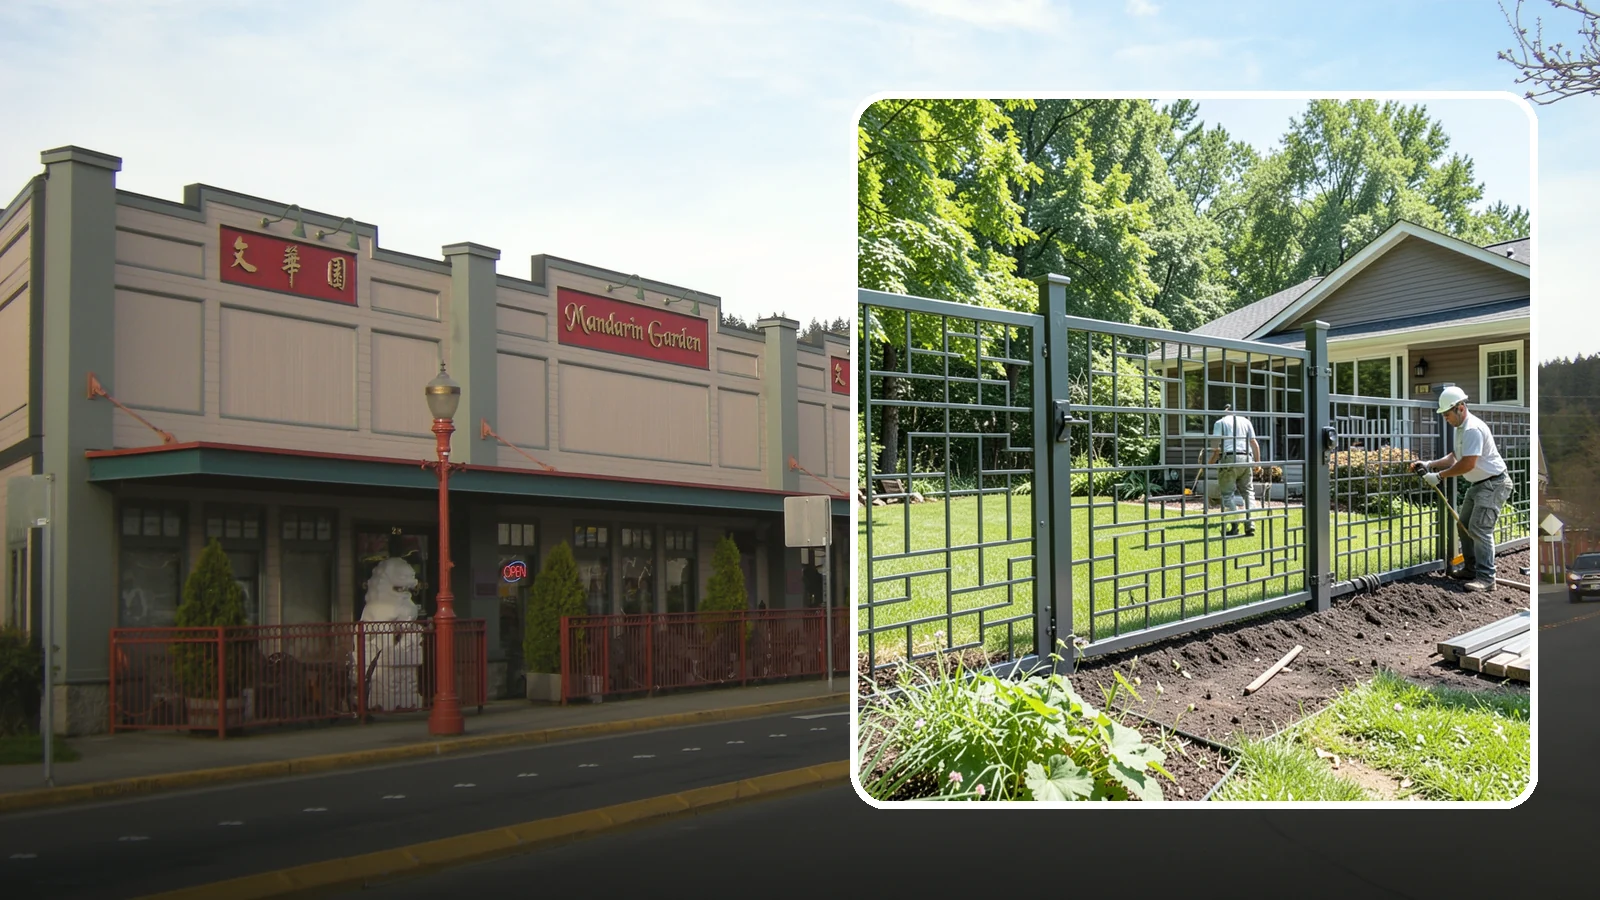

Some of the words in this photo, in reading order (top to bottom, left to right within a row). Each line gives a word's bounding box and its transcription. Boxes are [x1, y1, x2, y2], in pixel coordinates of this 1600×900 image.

[564, 302, 644, 341] Mandarin
[648, 320, 702, 352] Garden
[503, 565, 527, 578] OPEN
